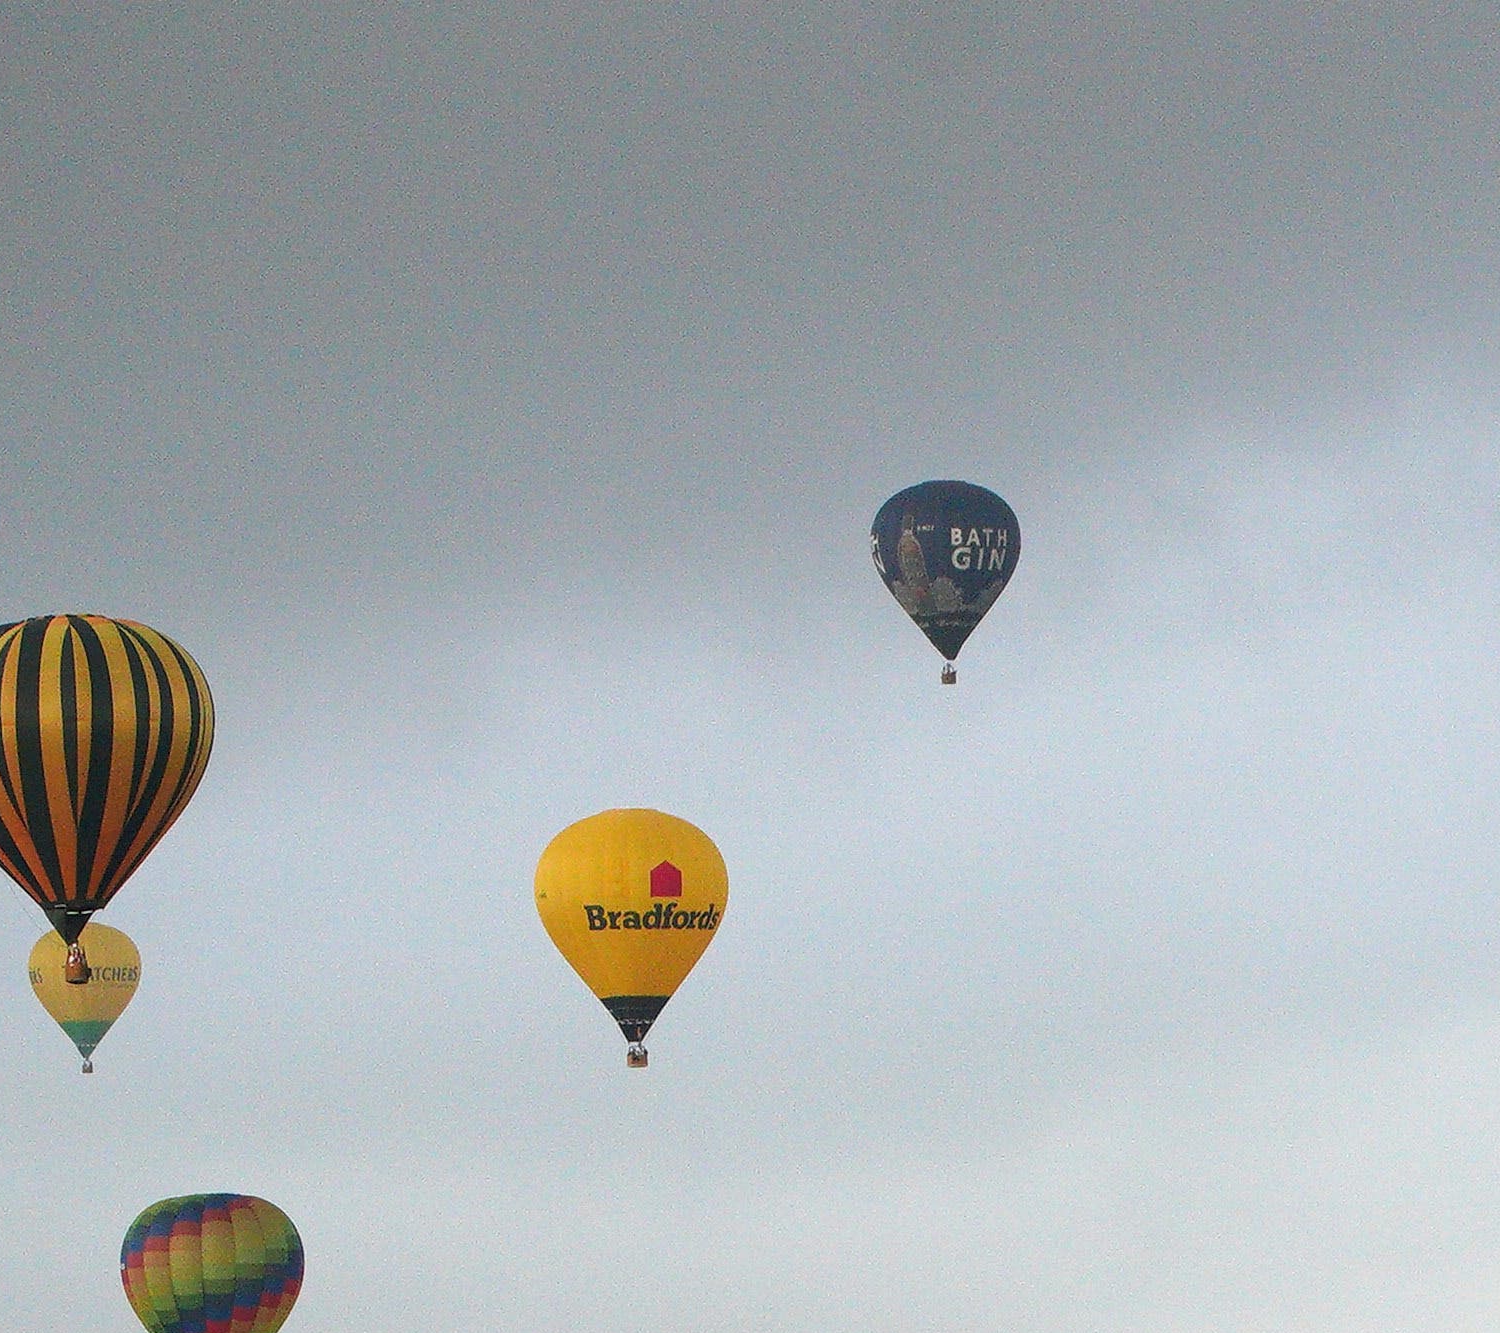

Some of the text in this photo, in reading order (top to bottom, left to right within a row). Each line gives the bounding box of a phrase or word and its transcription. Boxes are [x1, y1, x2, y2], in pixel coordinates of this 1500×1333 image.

[950, 527, 1007, 547] BATH
[950, 547, 1006, 570] GIN
[584, 902, 721, 931] Bradfords
